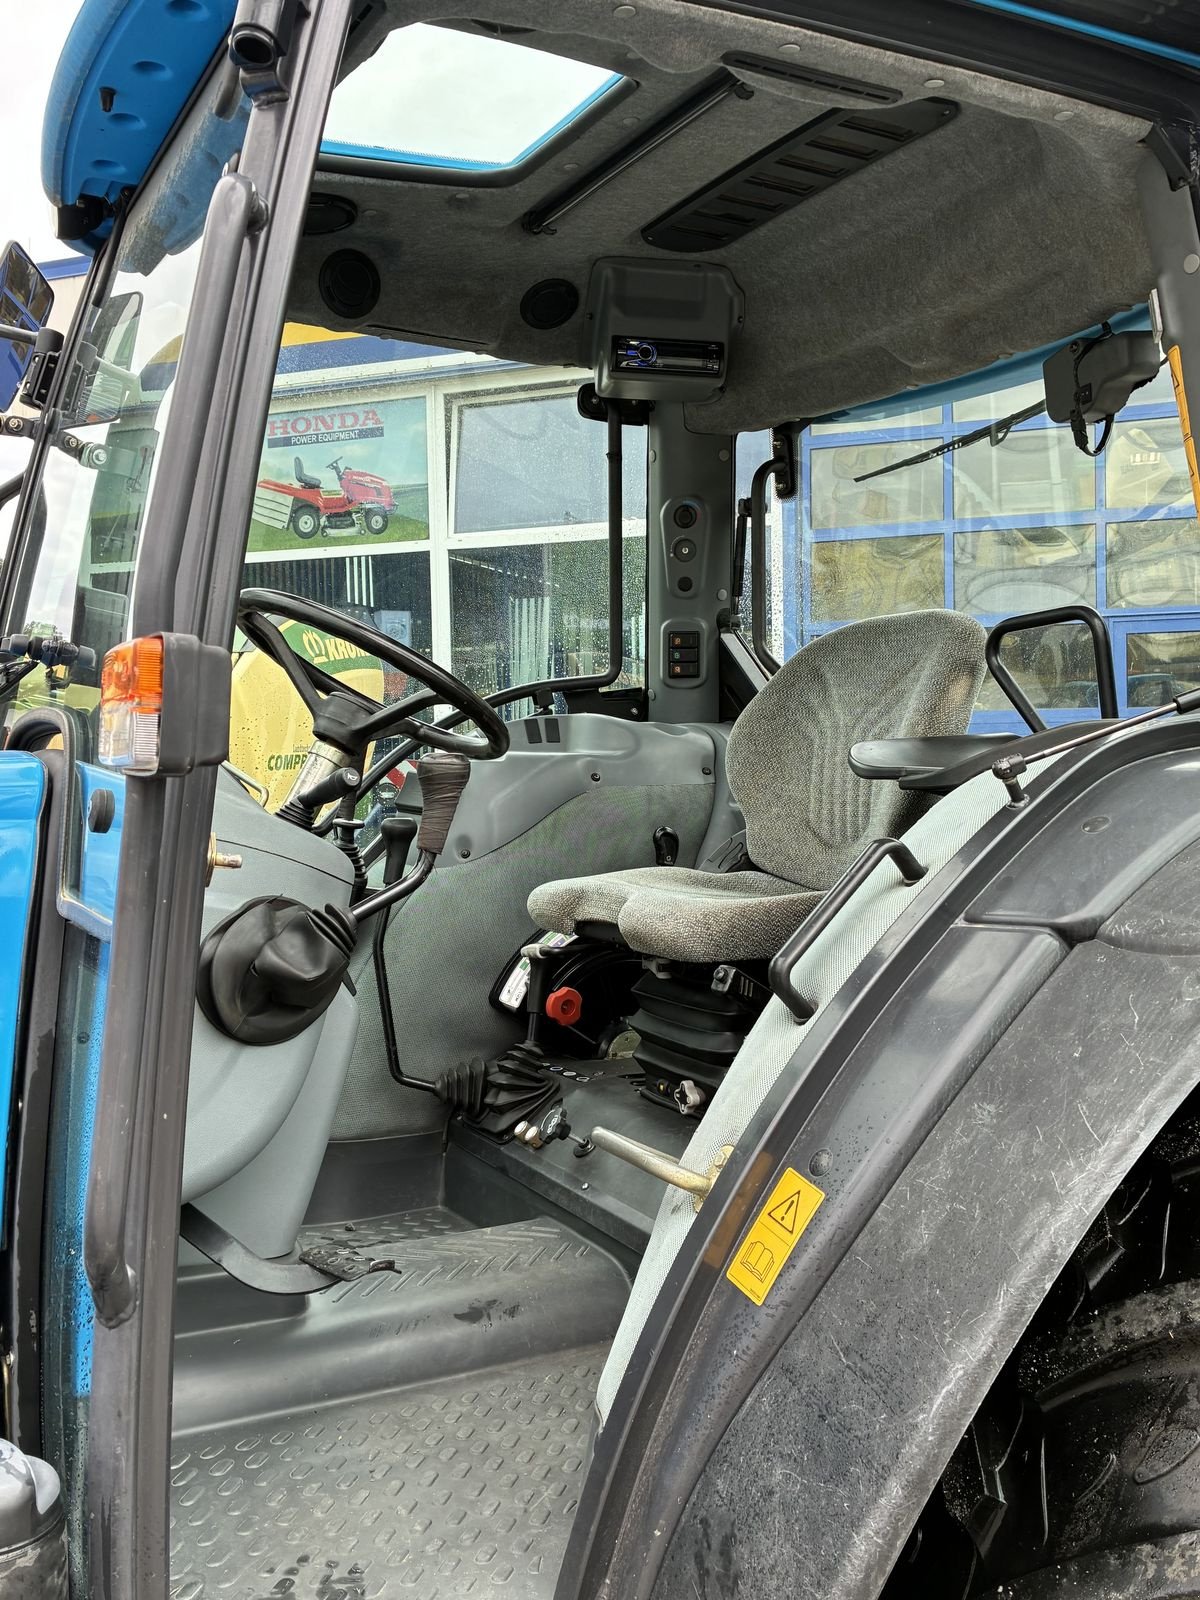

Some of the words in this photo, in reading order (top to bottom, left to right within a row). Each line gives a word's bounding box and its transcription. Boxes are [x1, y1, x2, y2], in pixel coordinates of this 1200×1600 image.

[268, 409, 384, 436] HONDA
[291, 434, 317, 445] POWER
[318, 430, 359, 442] EQUIPMENT
[325, 638, 371, 661] KRO
